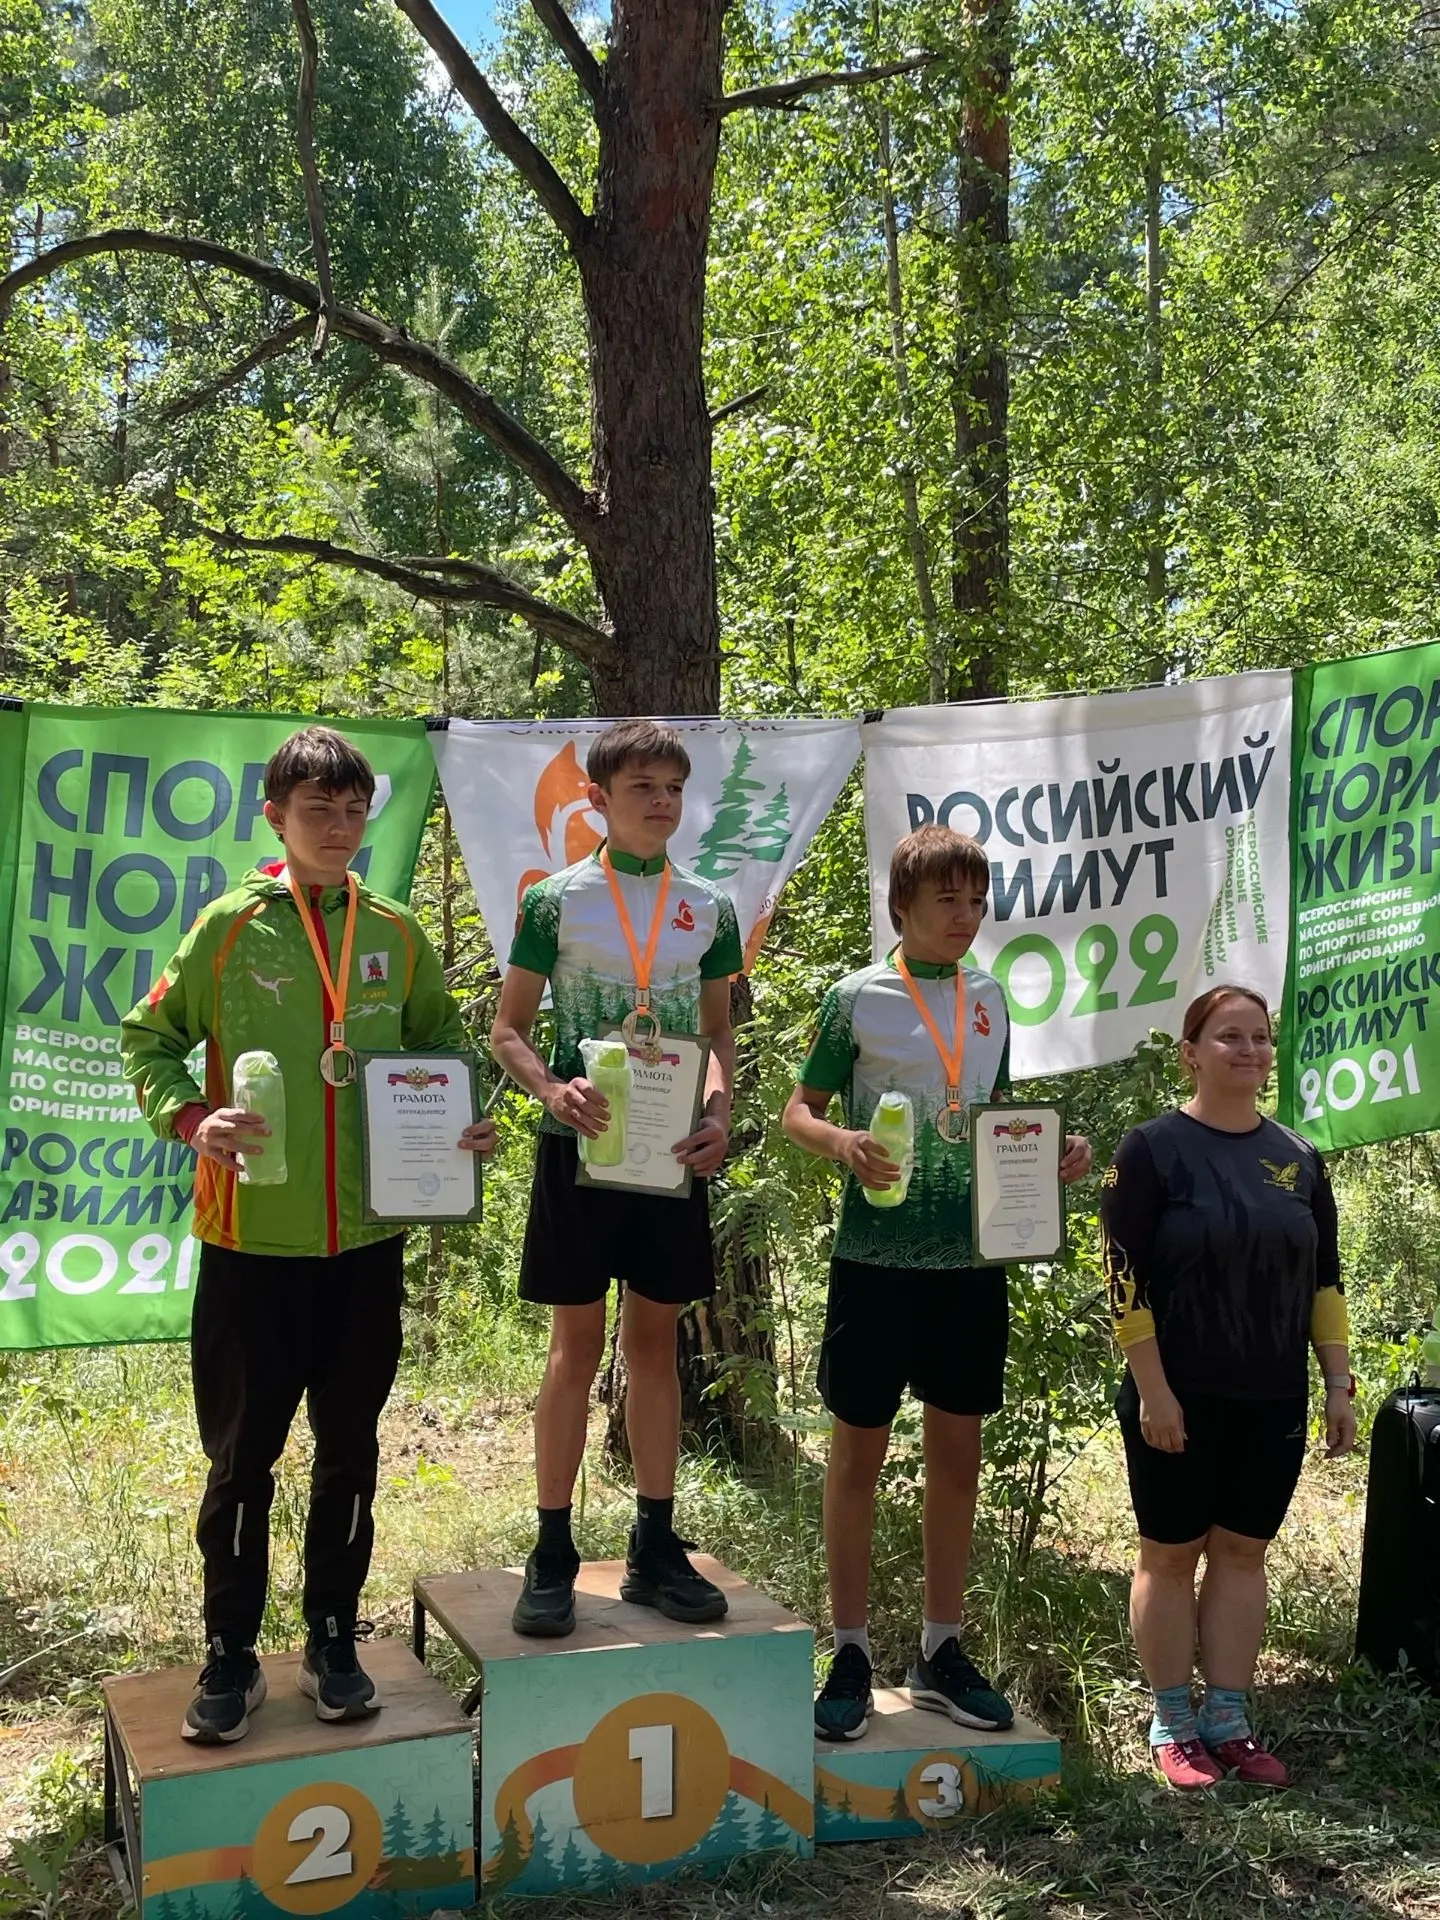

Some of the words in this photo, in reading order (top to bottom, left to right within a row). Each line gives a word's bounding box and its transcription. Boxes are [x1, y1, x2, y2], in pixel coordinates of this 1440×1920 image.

[37, 749, 265, 841] СПОР
[906, 730, 1275, 847] РОССИЙСКИЙ
[990, 837, 1174, 922] ИМУТ
[1299, 886, 1413, 925] ВСЕРОССИЙСКИЕ
[1299, 912, 1368, 943] МАССОВЫЕ
[1371, 892, 1440, 923] СОРЕВНО
[1299, 945, 1313, 961] ПО
[1315, 918, 1421, 955] СПОРТИВНОМУ
[1299, 932, 1426, 979] ОРИЕНТИРОВАНИЮ
[959, 914, 1179, 1027] 022
[1300, 996, 1429, 1065] АЗИМУТ
[10, 1071, 47, 1091] ПО
[53, 1079, 137, 1101] СПОРТ
[13, 1048, 122, 1077] МАССОВ
[632, 1068, 673, 1082] АМОТА
[1300, 1043, 1421, 1124] 2021
[9, 1095, 143, 1123] ОРИЕНТИР
[393, 1094, 446, 1104] ГРАМОТА
[996, 1143, 1038, 1154] ГРАМОТА
[0, 1180, 194, 1226] АЗИМУ
[0, 1231, 195, 1301] 2021
[628, 1724, 673, 1819] 1
[918, 1762, 964, 1818] 3
[284, 1804, 353, 1885] 2
